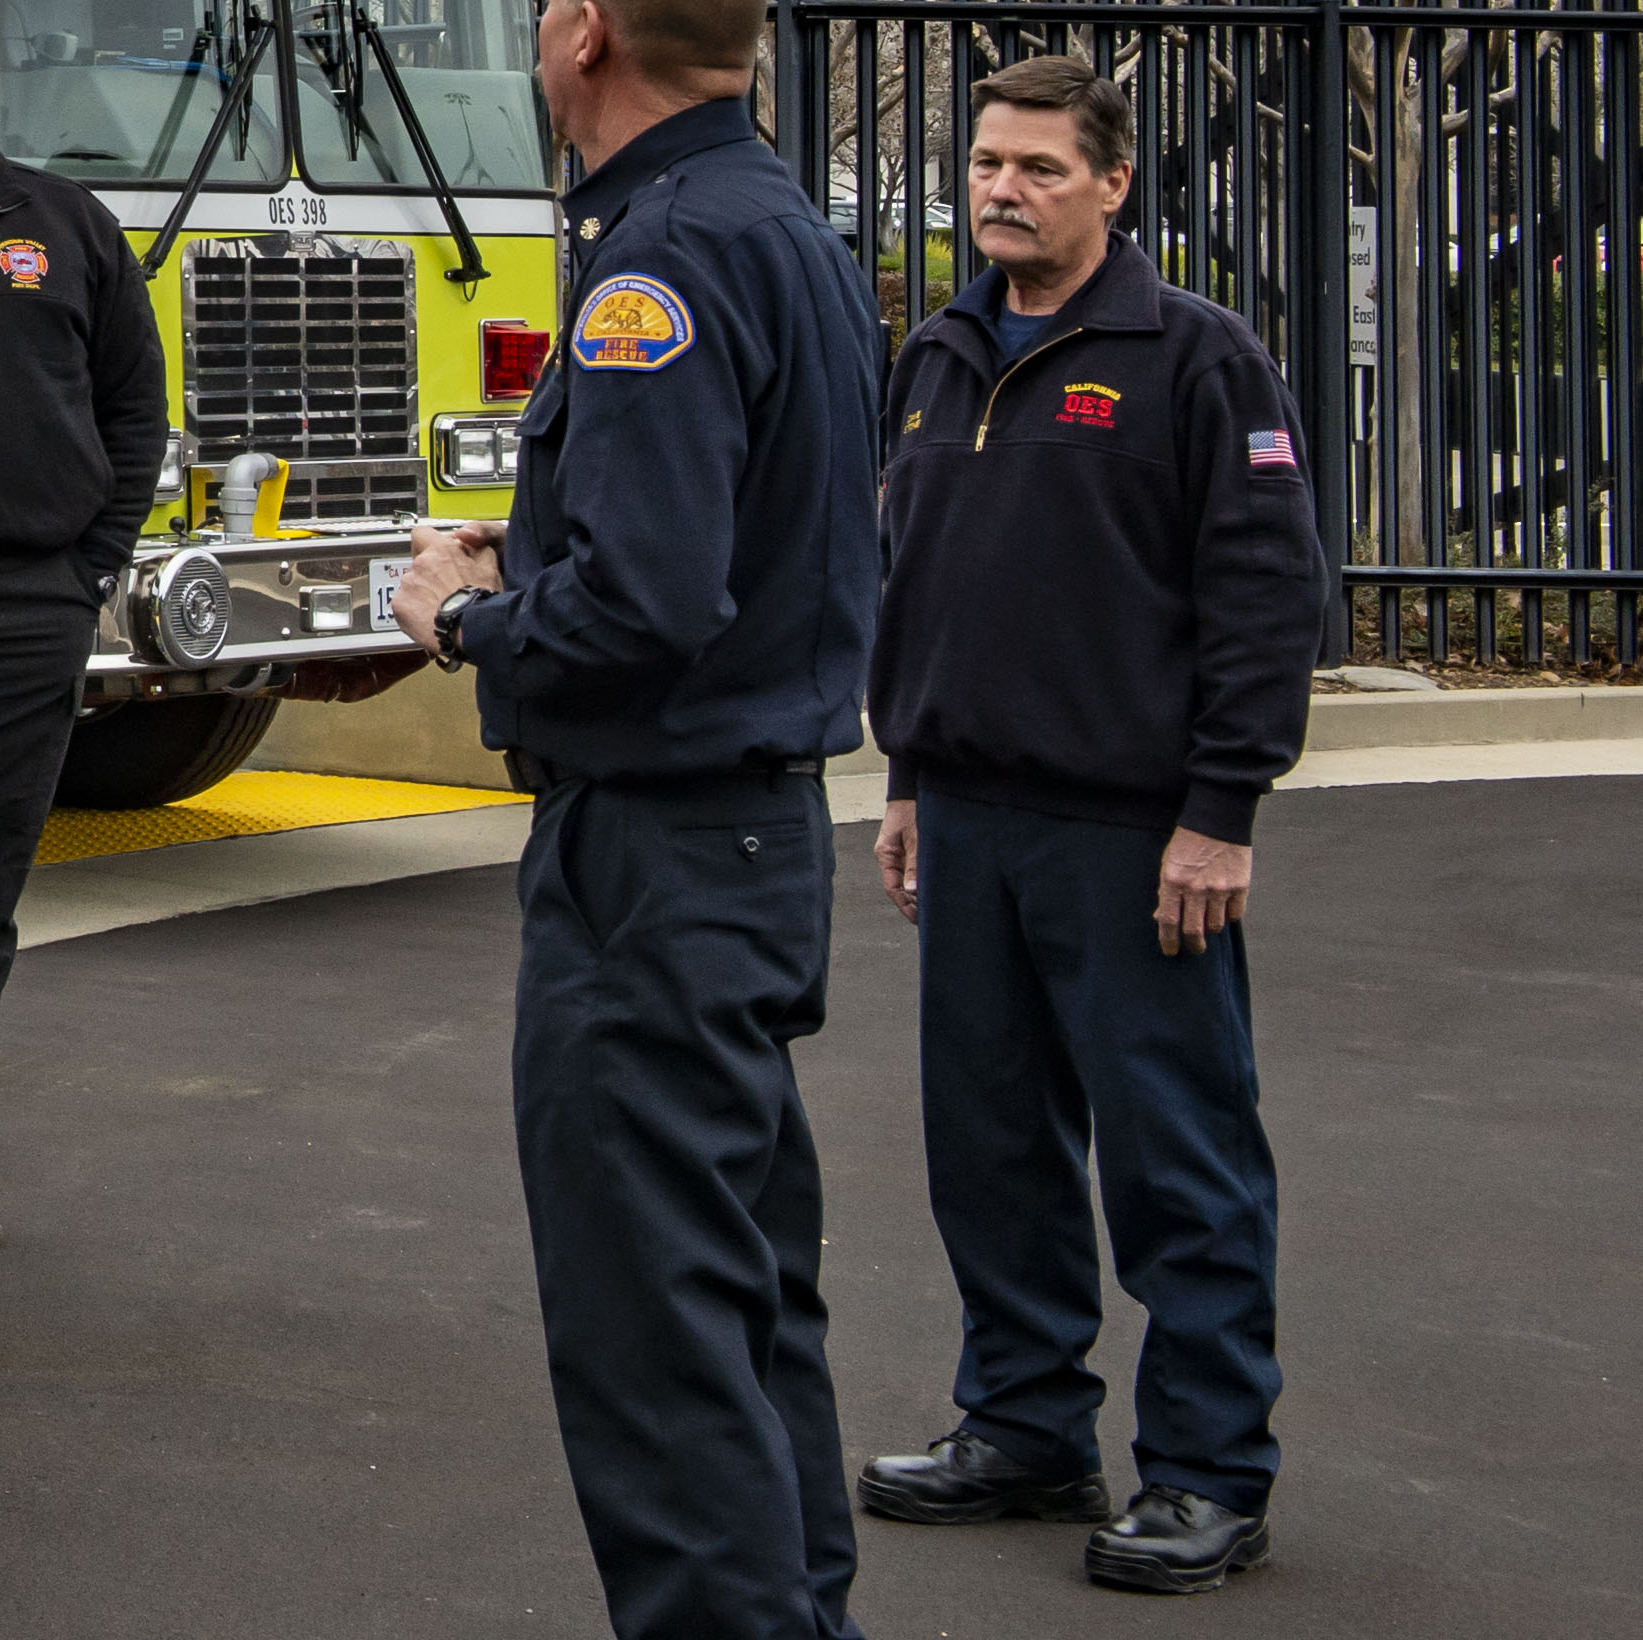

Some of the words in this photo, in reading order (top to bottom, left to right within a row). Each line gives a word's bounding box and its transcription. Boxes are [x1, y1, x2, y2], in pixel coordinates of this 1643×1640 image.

[268, 196, 295, 225] OES
[301, 198, 327, 225] 398
[1349, 220, 1366, 242] try
[1350, 246, 1371, 266] sed
[617, 280, 628, 289] OF
[628, 280, 672, 308] EMERGENCY
[605, 339, 639, 349] FIRE
[596, 349, 648, 361] RESCUE
[1064, 382, 1122, 401] CALIFORNIA
[1064, 393, 1114, 418] OES
[388, 568, 399, 578] CA
